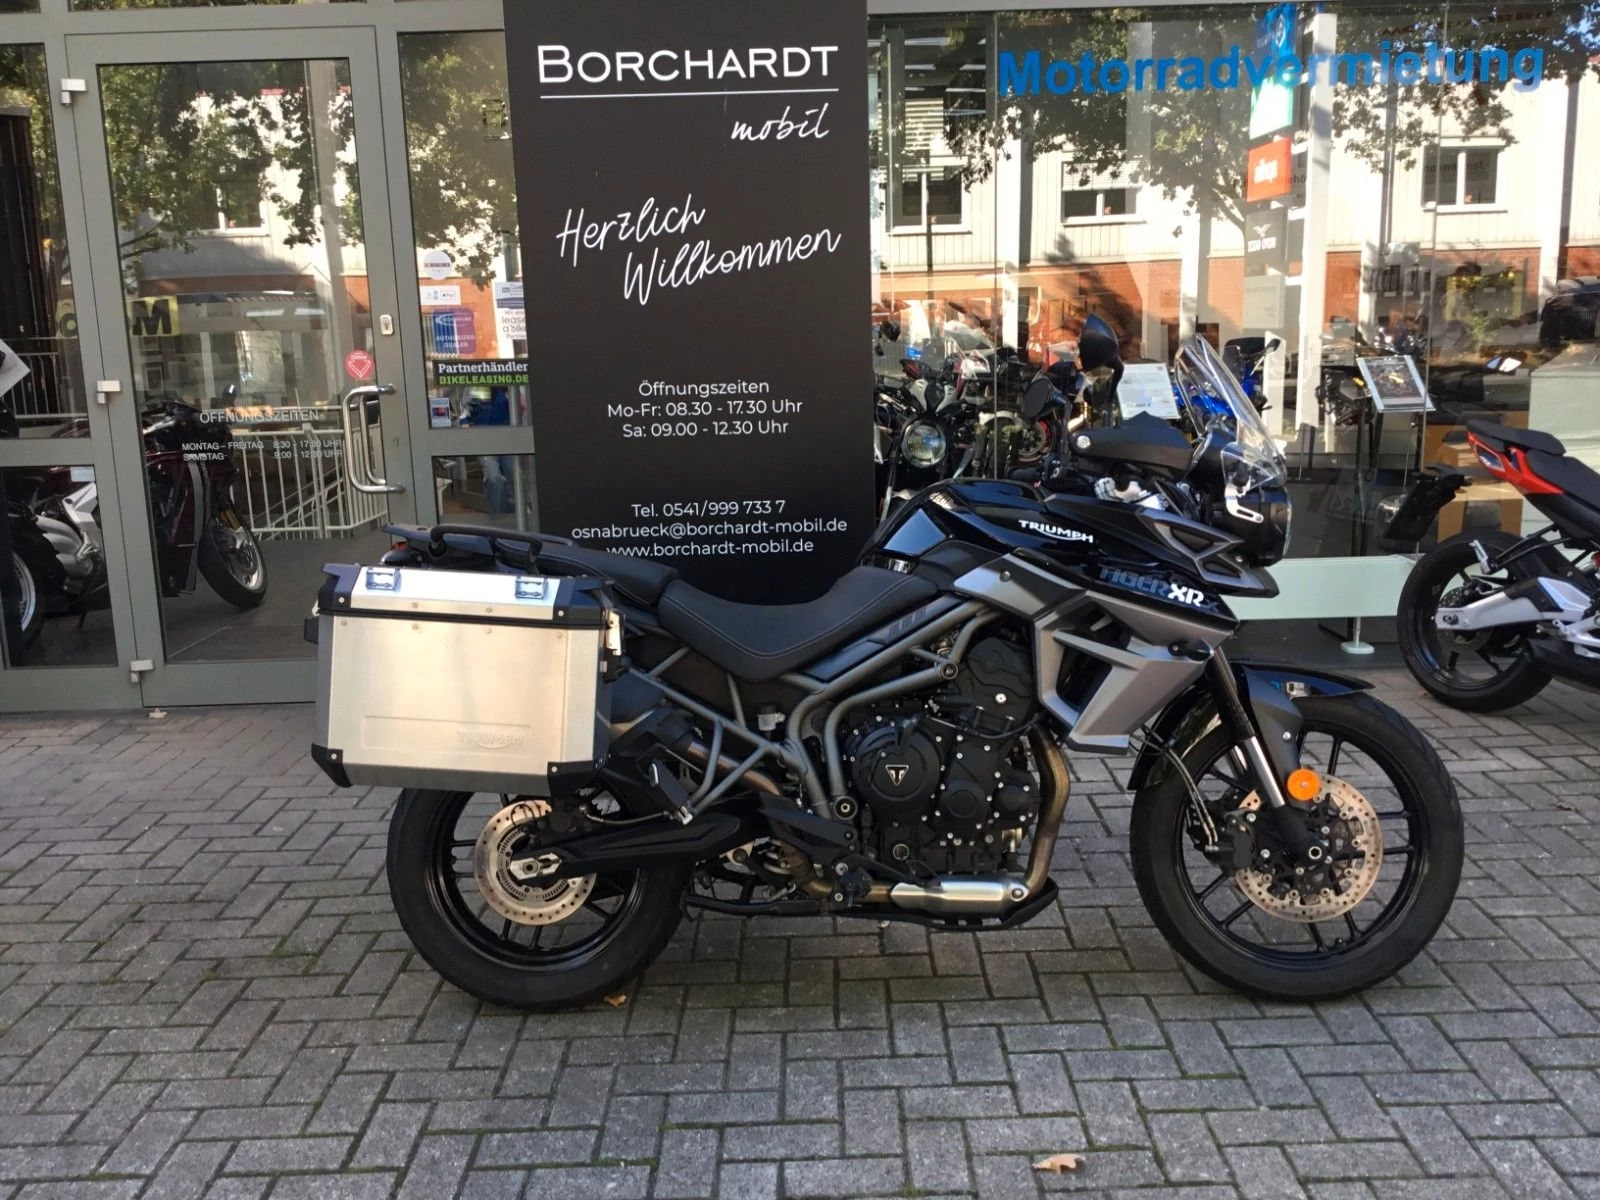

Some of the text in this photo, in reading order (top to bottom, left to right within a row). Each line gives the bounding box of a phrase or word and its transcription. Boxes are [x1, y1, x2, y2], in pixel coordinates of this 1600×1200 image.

[999, 40, 1544, 93] Motorradvermietung
[731, 102, 830, 141] mobil
[556, 194, 706, 267] Herzlich
[623, 229, 842, 305] Willkommen
[438, 362, 529, 374] Partnerhändler
[439, 374, 529, 385] BIKELEASING.DE
[638, 379, 770, 398] Öffnungszeiten
[607, 402, 662, 417] Mo-Fr:
[665, 400, 713, 416] 08.30
[727, 399, 767, 415] 17.30
[771, 398, 803, 413] Uhr
[622, 423, 648, 437] Sa:
[650, 421, 698, 437] 09.00
[712, 420, 753, 435] 12.30
[757, 419, 789, 434] Uhr
[228, 441, 264, 449] FREITAG
[631, 503, 659, 517] Tel.
[663, 500, 739, 517] 0541/999
[743, 501, 772, 514] 733
[571, 518, 848, 539] osnabrueck@borchardt-mobil.de
[1018, 519, 1094, 543] TRIUMPH
[606, 538, 814, 556] www.borchardt-mobil.de
